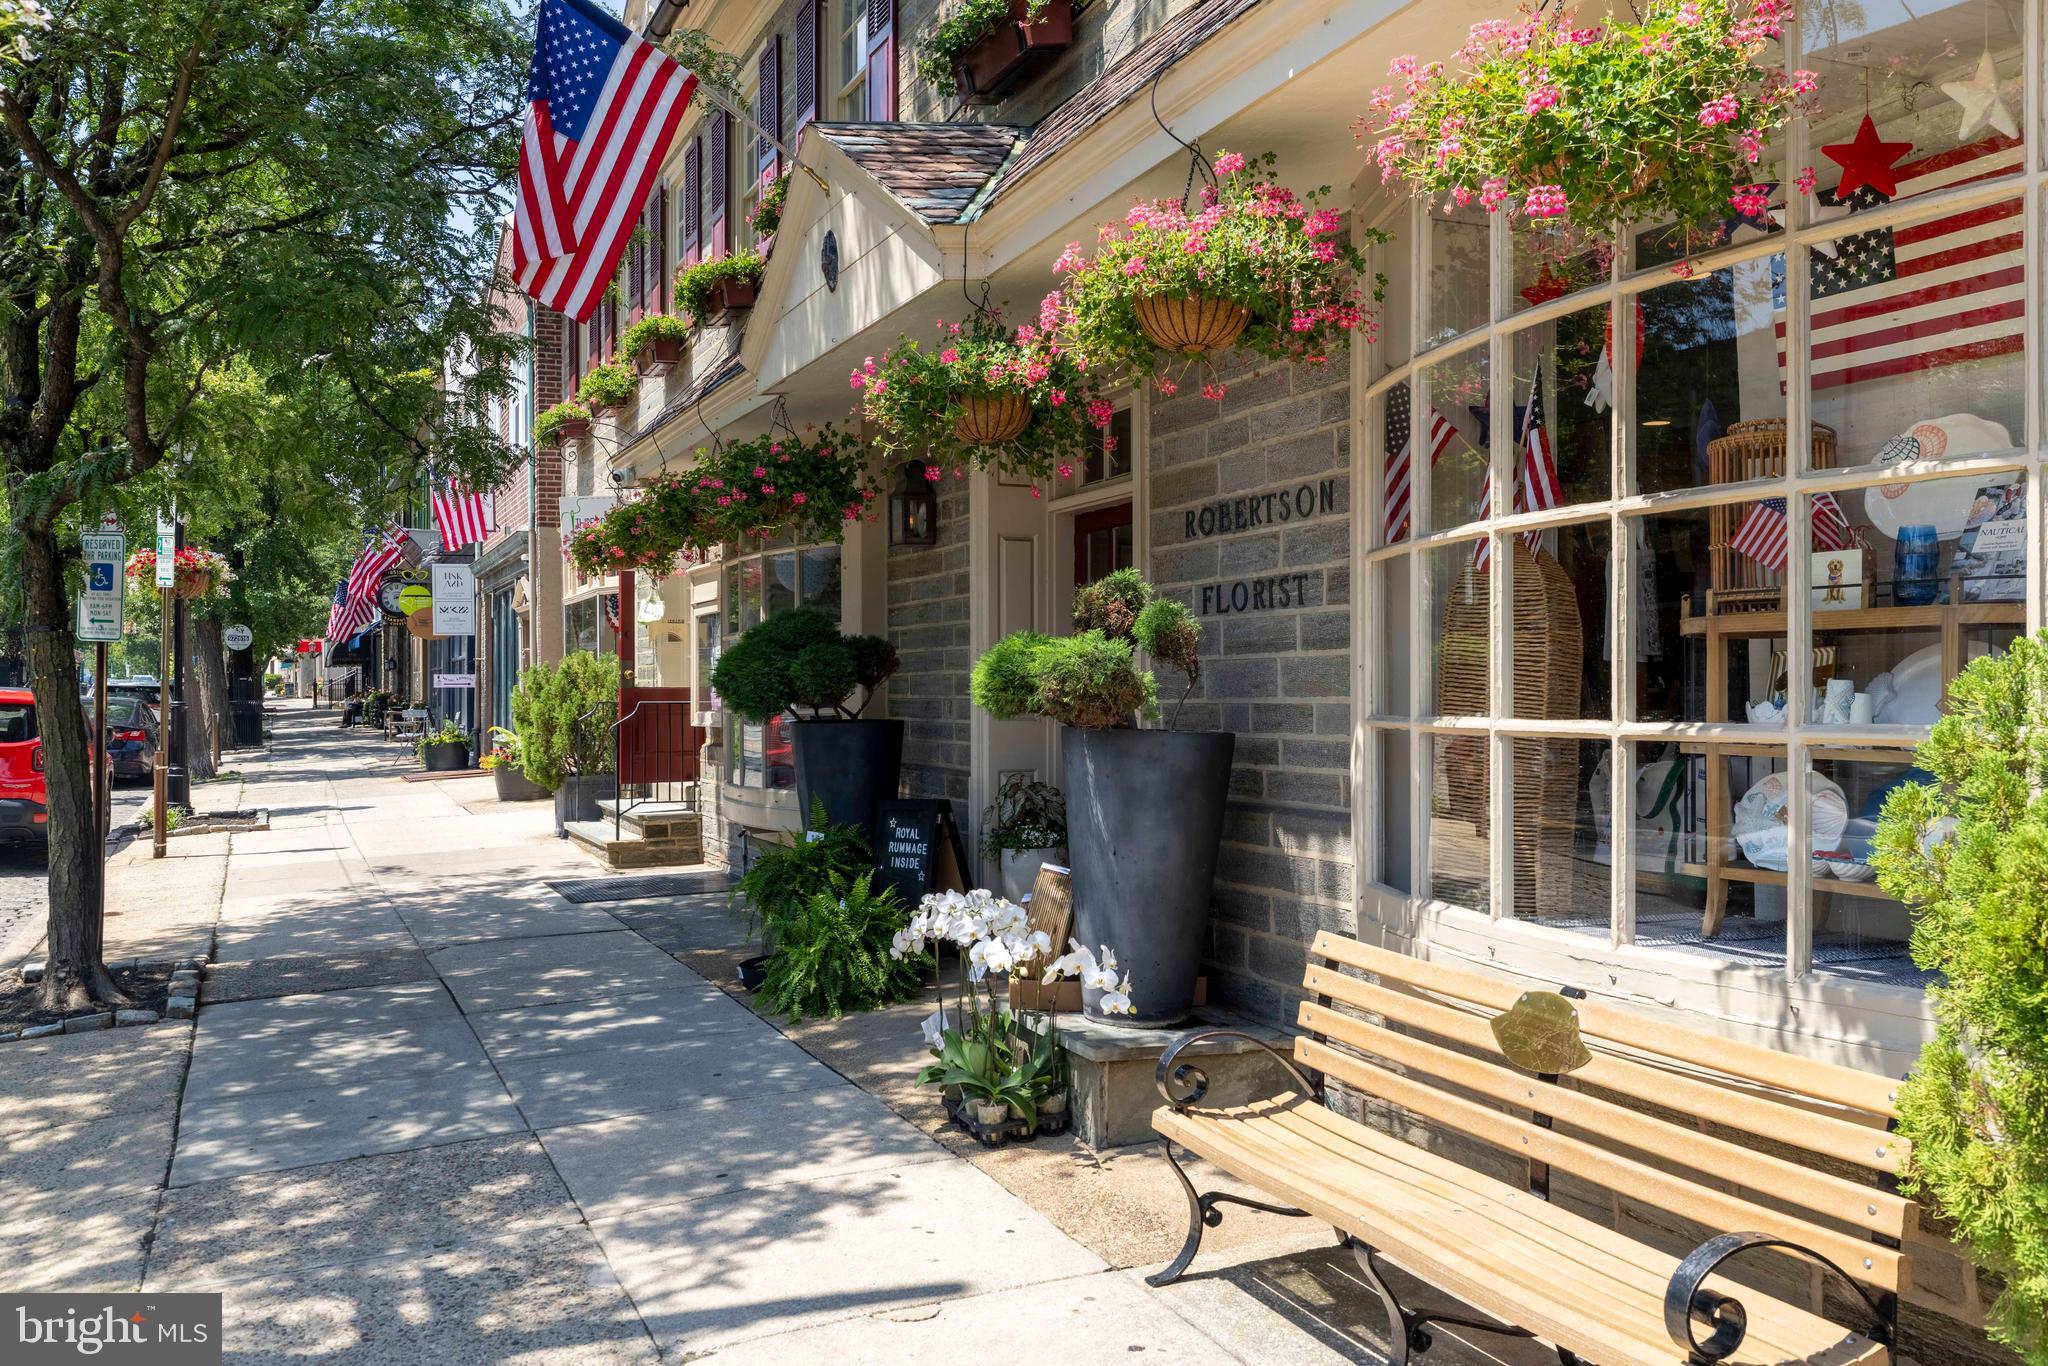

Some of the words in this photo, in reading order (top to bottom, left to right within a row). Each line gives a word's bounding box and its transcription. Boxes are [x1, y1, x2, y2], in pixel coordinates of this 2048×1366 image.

[1185, 479, 1334, 538] ROBERTSON
[85, 539, 121, 549] RESERVED
[97, 551, 121, 561] PARKING
[1202, 573, 1308, 614] FLORIST
[895, 827, 920, 840] ROYAL
[888, 841, 928, 855] RUMMAGE
[890, 856, 921, 869] INSIDE
